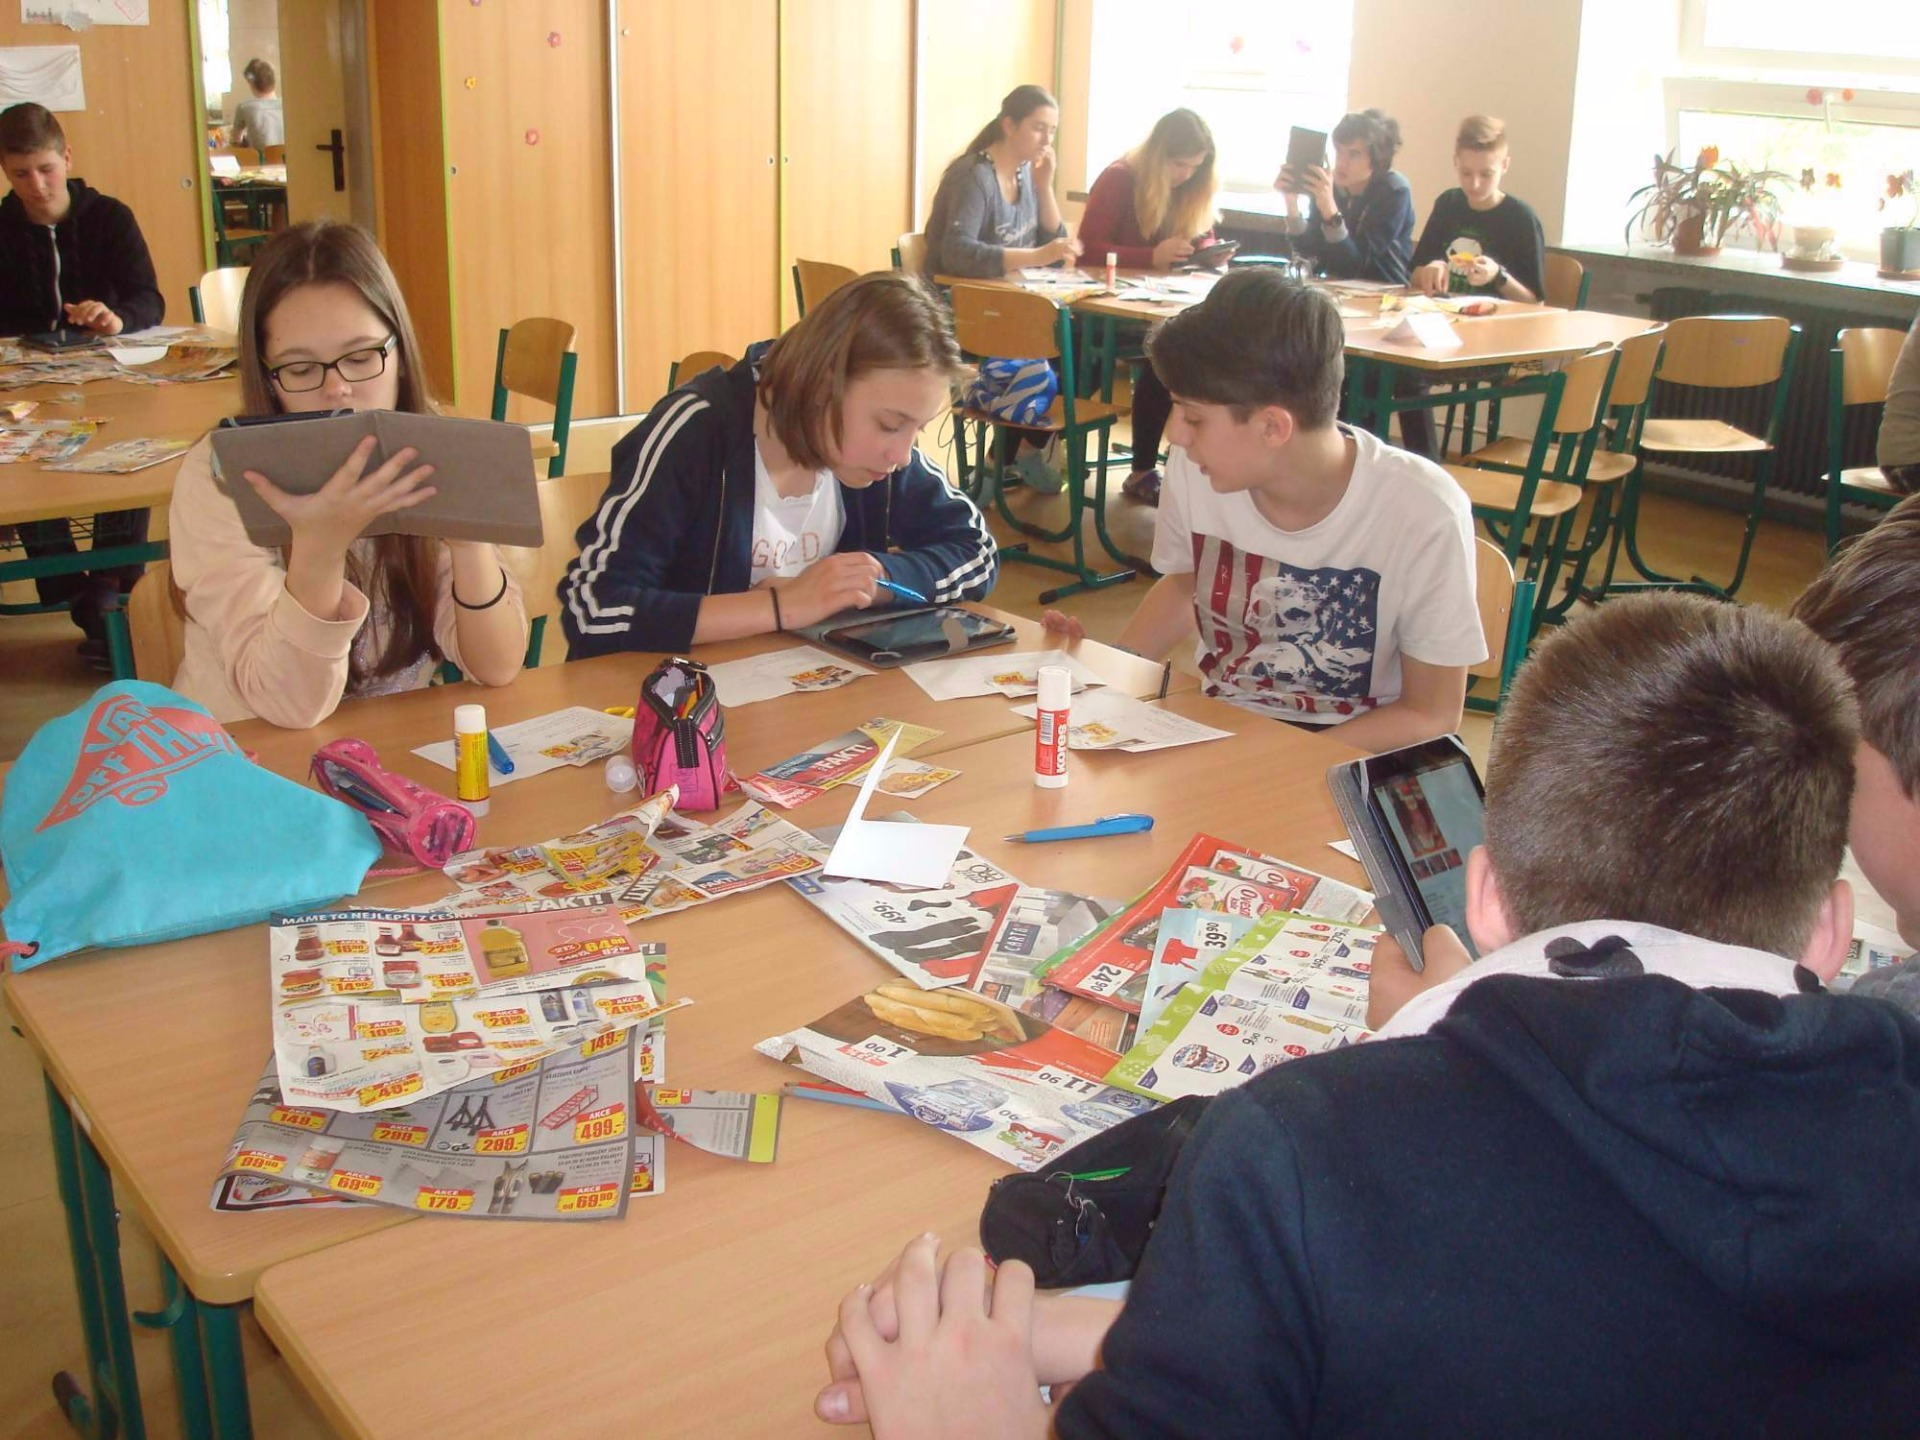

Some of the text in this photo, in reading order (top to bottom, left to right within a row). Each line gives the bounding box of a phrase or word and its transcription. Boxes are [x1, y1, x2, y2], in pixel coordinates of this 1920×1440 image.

[527, 893, 604, 913] FAKT!
[616, 996, 639, 1004] AKCE
[288, 1108, 311, 1116] AKCE
[589, 1108, 611, 1120] AKCE
[491, 1128, 515, 1137] AKCE
[250, 1151, 275, 1159] AKCE
[346, 1171, 370, 1179] AKCE
[577, 1185, 601, 1194] AKCE
